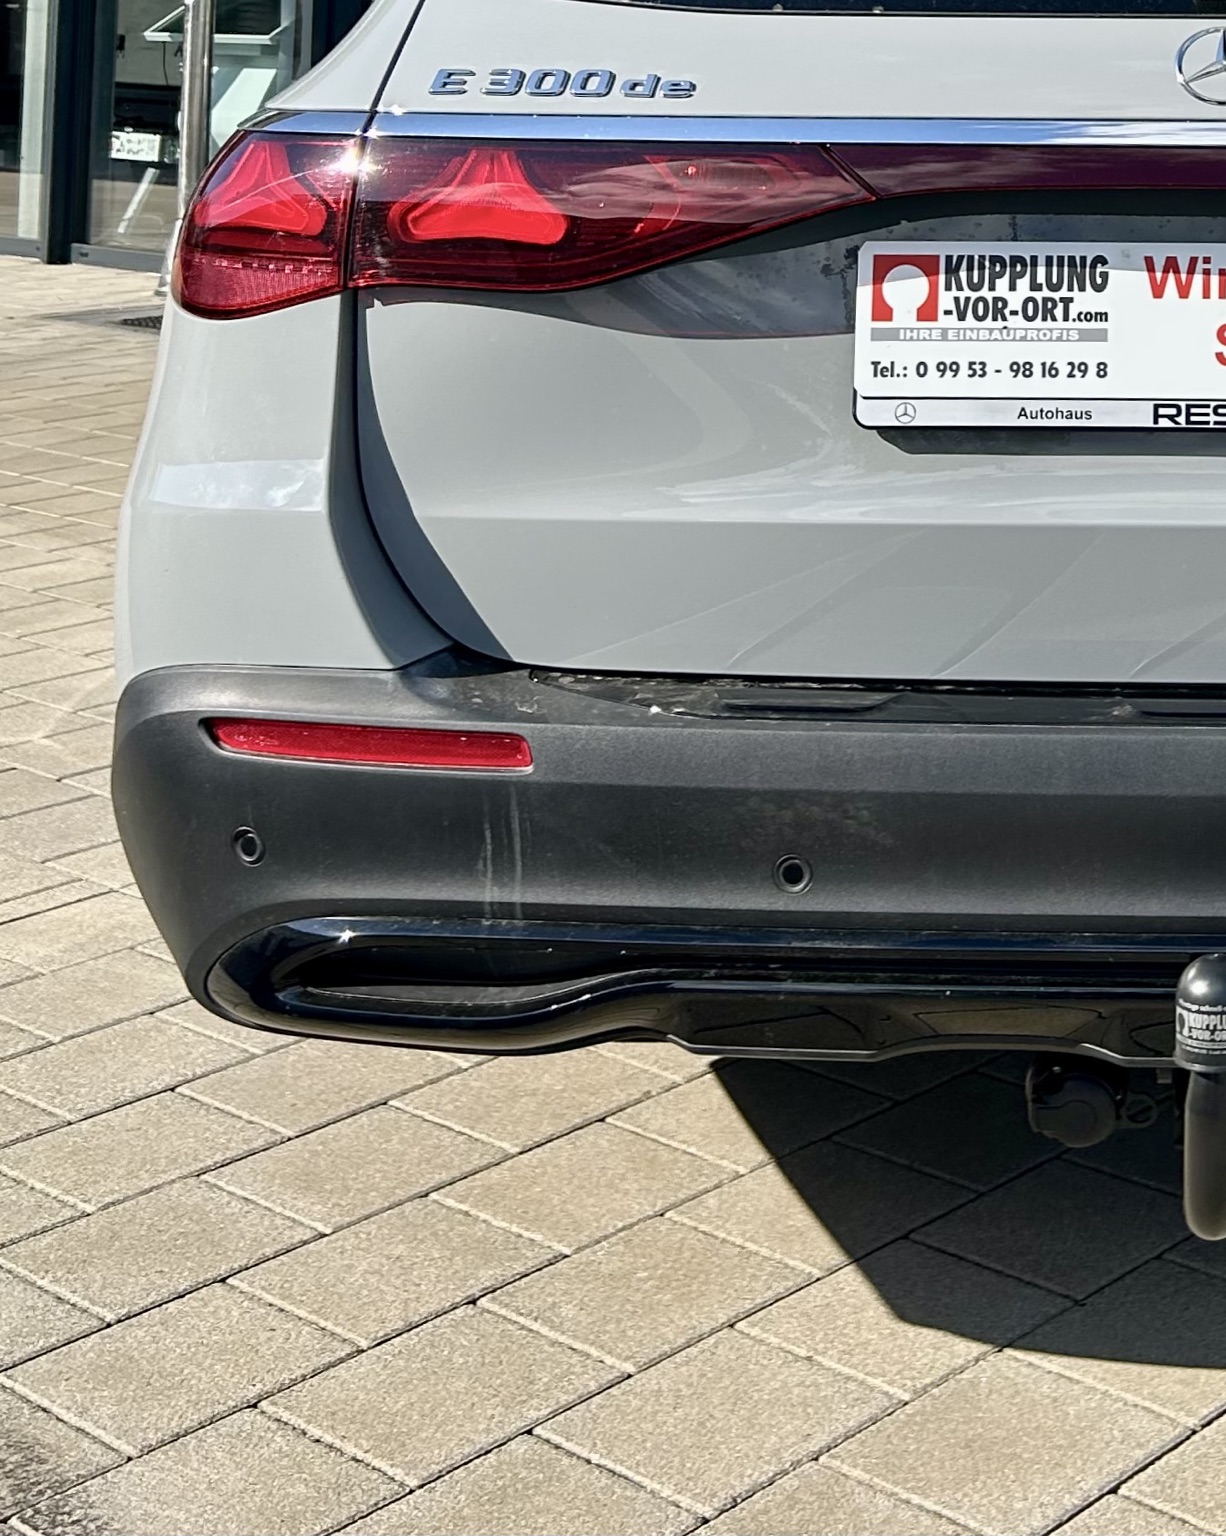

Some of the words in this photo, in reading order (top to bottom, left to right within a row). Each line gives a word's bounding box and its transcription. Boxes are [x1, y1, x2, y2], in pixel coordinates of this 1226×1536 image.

[944, 254, 1109, 293] KUPPLUNG
[943, 296, 1109, 323] -VOR-ORT.com
[900, 329, 943, 341] IHRE
[947, 328, 1080, 341] EINBAUPROFIS
[871, 361, 908, 378] Tel.:
[915, 361, 928, 378] 0
[936, 361, 961, 378] 99
[967, 361, 988, 378] 53
[1009, 361, 1034, 378] 98
[1041, 361, 1059, 378] 16
[1066, 361, 1089, 378] 29
[1096, 361, 1109, 378] 8
[1017, 406, 1093, 421] Autohaus
